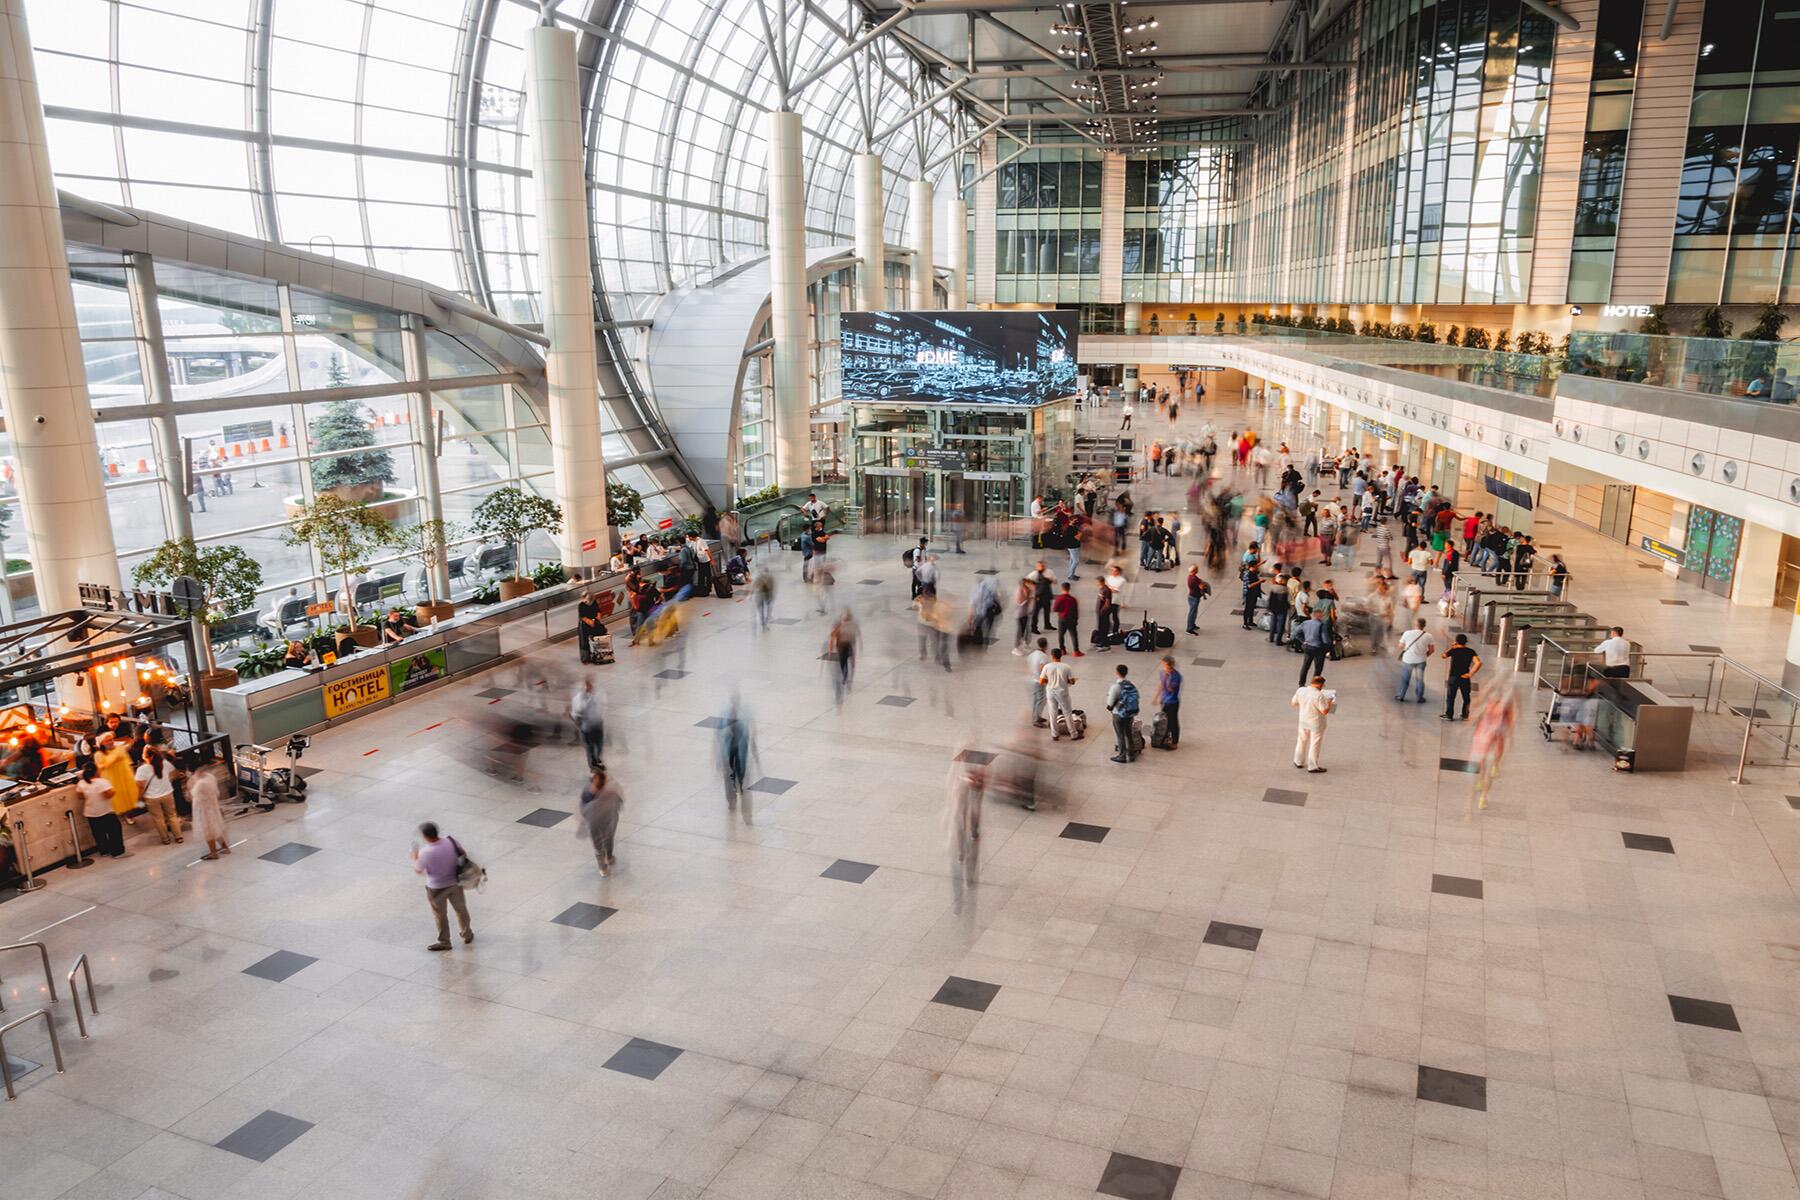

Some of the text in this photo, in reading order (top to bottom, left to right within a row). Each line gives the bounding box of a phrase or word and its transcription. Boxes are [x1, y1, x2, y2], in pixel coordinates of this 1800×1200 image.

[1603, 305, 1655, 317] HOTEL
[916, 350, 958, 364] #DME
[328, 668, 385, 694] ГОСТИНИЦА
[333, 680, 384, 707] HOTEL
